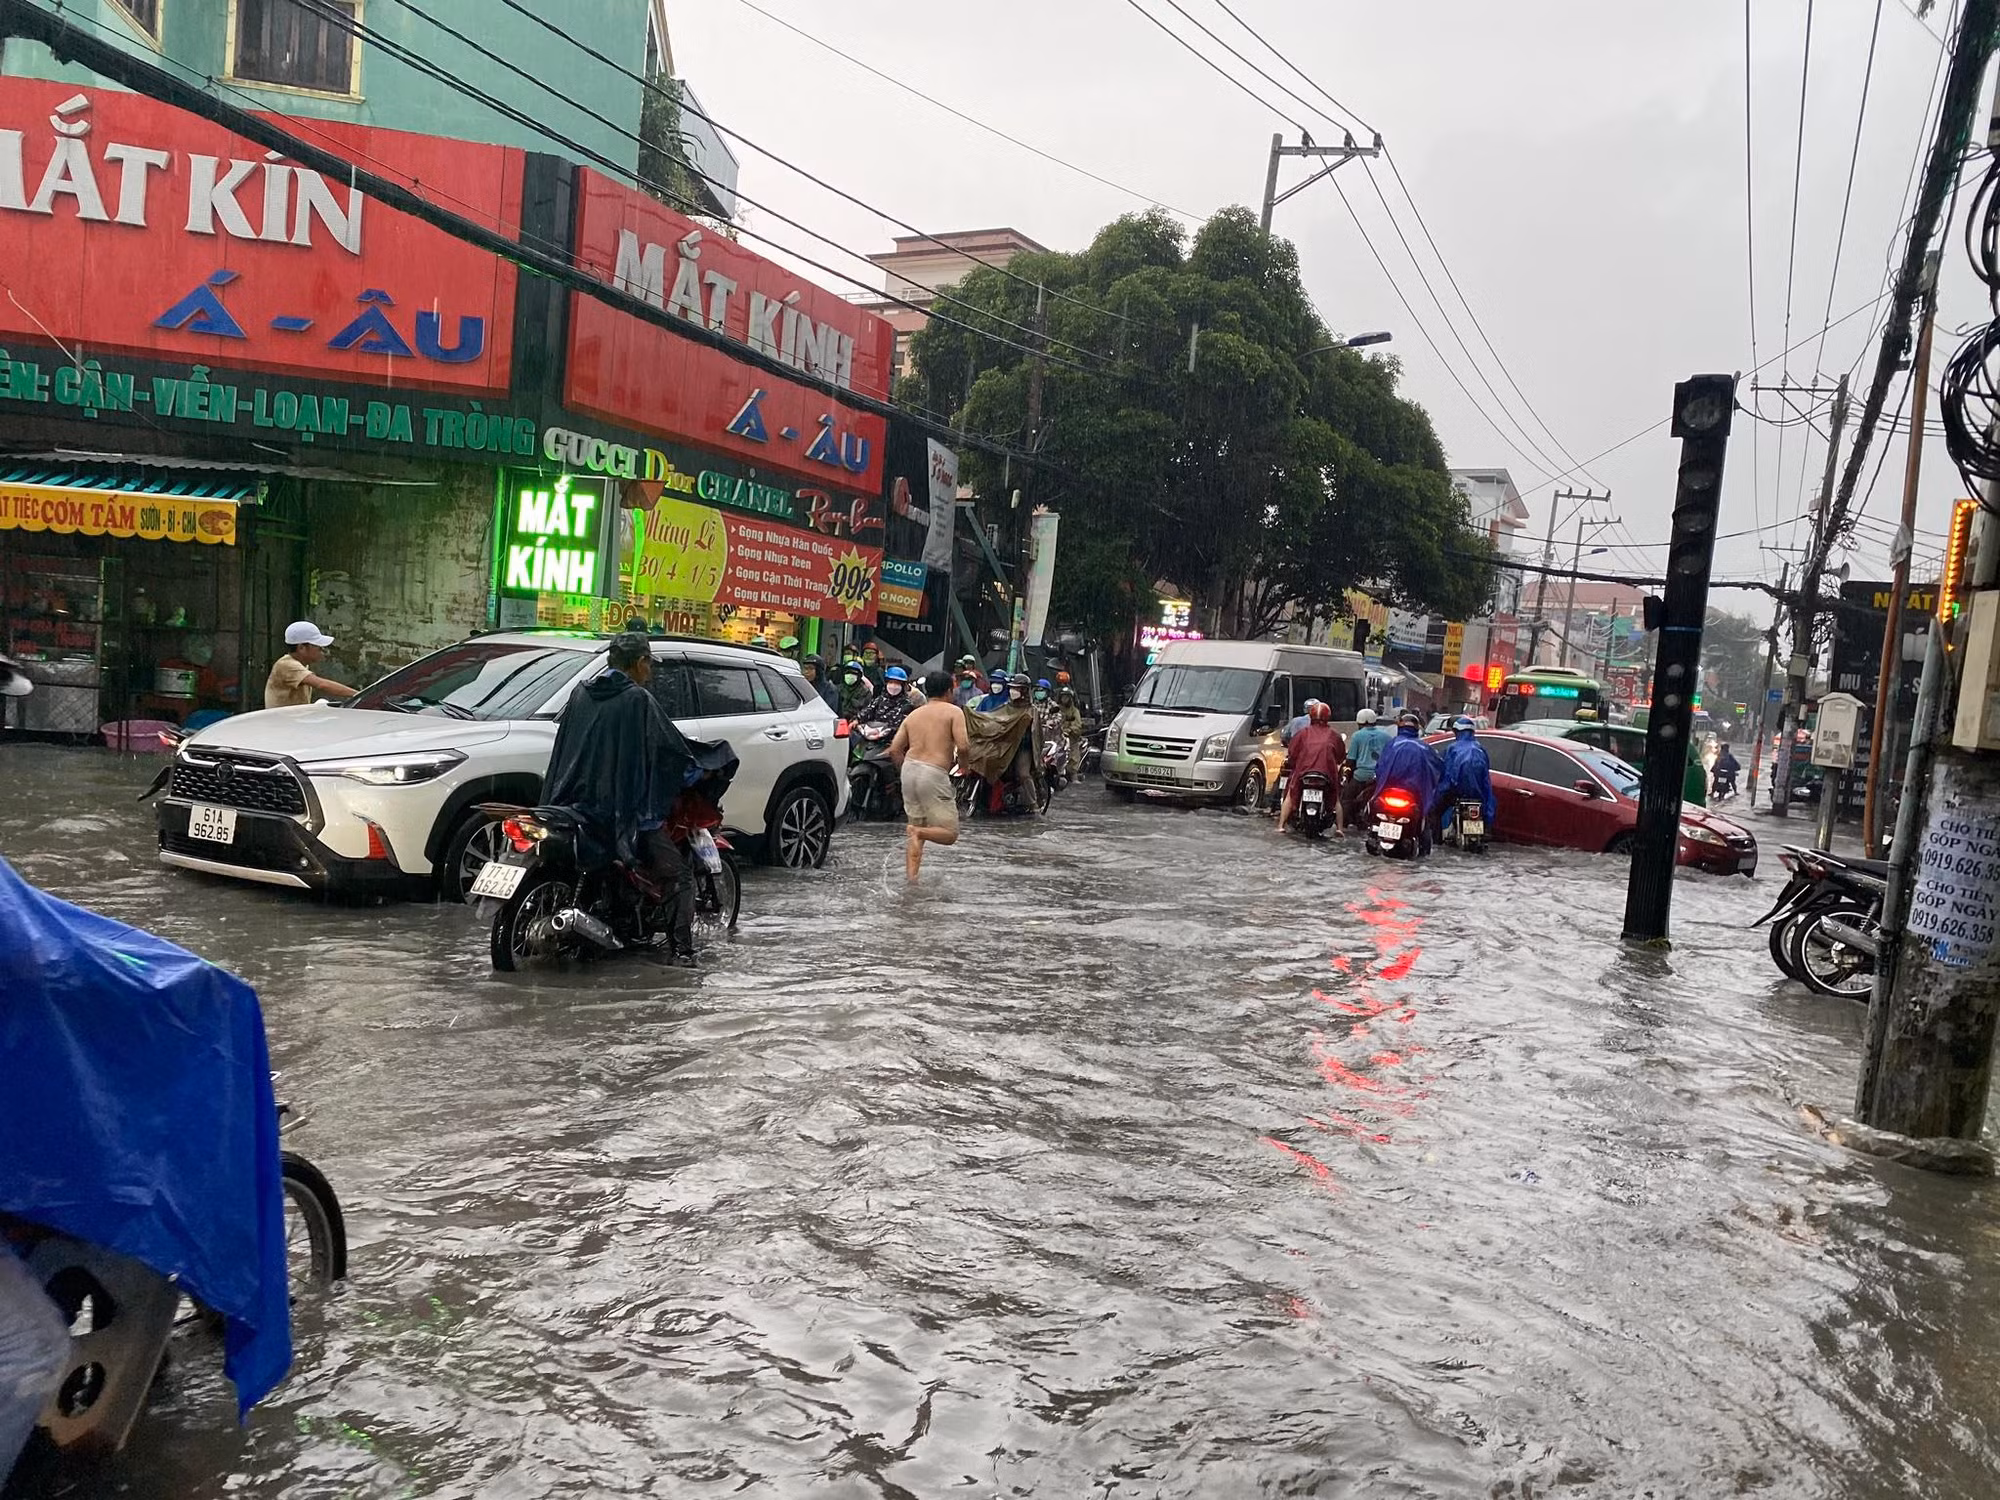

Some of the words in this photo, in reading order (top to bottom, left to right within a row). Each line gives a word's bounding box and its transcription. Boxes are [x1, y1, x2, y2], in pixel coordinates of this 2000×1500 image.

[152, 269, 248, 339] Á
[328, 288, 485, 363] ÂU
[748, 290, 855, 391] KÍNH
[423, 401, 536, 456] TRÒNG
[726, 389, 769, 444] Á
[805, 414, 870, 474] ÂU
[544, 427, 639, 480] GUCCI
[41, 497, 84, 526] CƠM
[91, 494, 135, 530] TẤM
[517, 474, 596, 538] MẮT
[739, 525, 763, 542] Gọng
[766, 531, 790, 547] Nhựa
[792, 537, 809, 552] Hàn
[812, 542, 834, 556] Quốc
[506, 537, 596, 594] KÍNH
[737, 545, 762, 560] Gọng
[764, 550, 788, 566] Nhựa
[791, 555, 812, 570] Teen
[736, 566, 760, 581] Gọng
[763, 571, 781, 586] Cận
[805, 579, 829, 594] Trang
[734, 587, 758, 602] Gọng
[761, 591, 780, 604] Kim
[782, 594, 801, 609] Loại
[889, 593, 918, 607] NGỌC
[204, 808, 223, 824] 61A
[1941, 820, 1970, 835] CHO
[194, 822, 229, 841] 962.85
[1930, 832, 1961, 848] GÓP
[1927, 880, 1955, 895] CHO
[1917, 891, 1946, 908] GÓP
[1951, 901, 1999, 921] NGÀY
[1912, 908, 1995, 944] 0919.626.358
